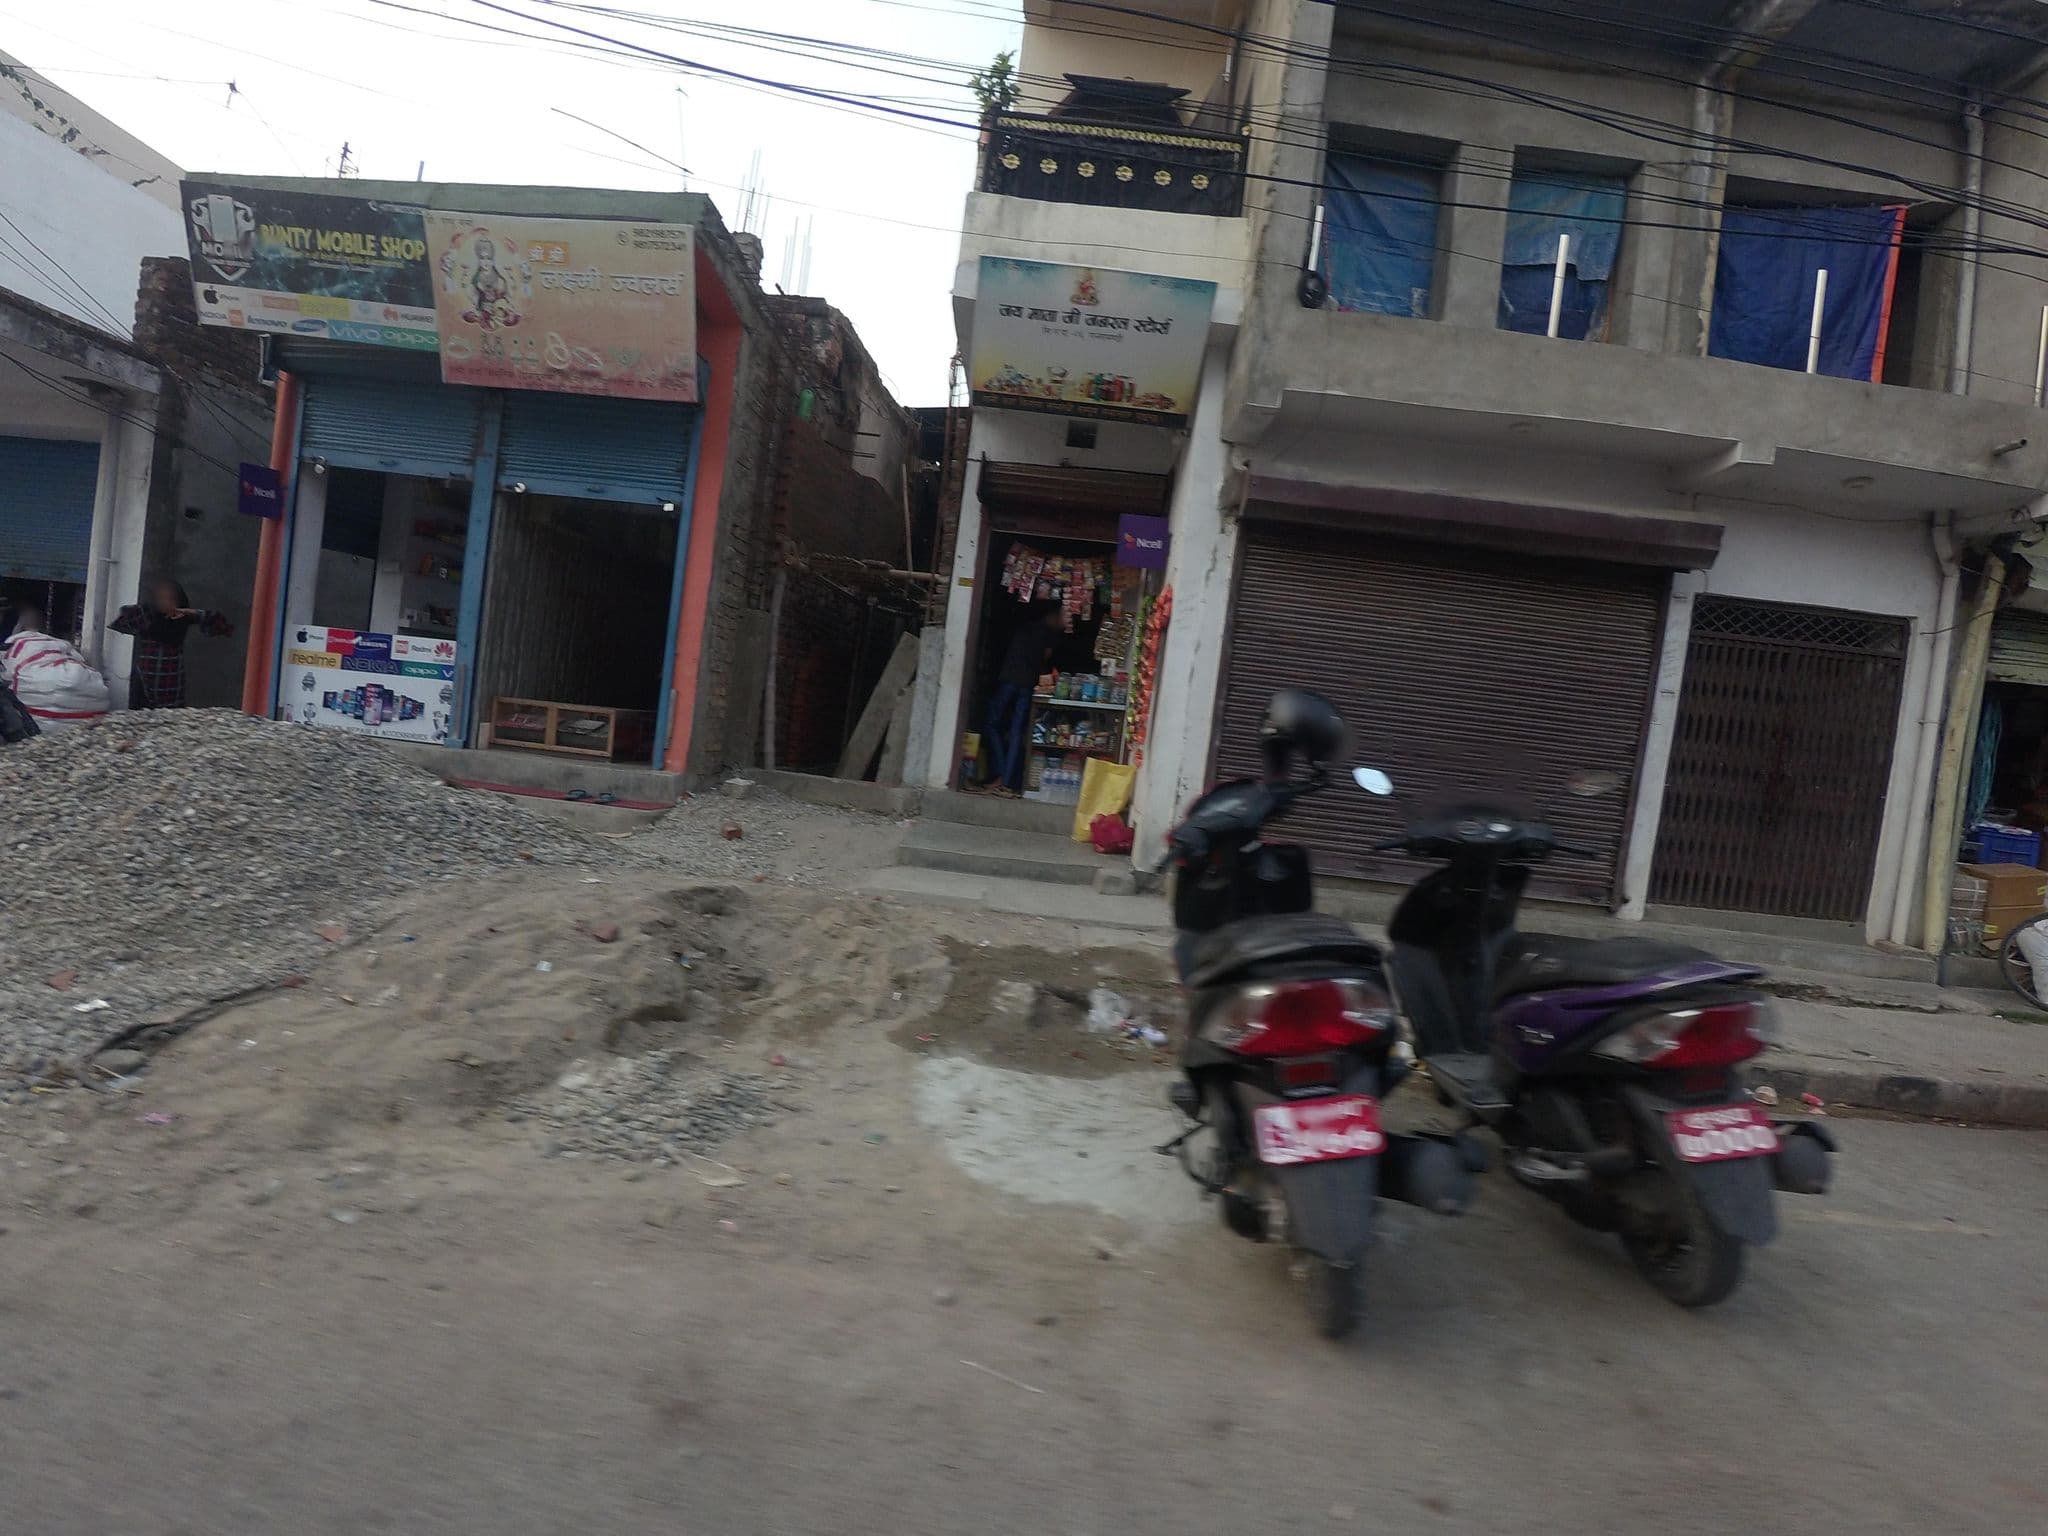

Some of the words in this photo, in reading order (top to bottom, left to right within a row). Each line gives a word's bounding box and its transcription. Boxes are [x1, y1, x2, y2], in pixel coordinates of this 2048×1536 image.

[316, 229, 377, 257] MOBILE
[380, 235, 426, 262] SHOP
[1136, 537, 1163, 550] Ncell
[291, 653, 337, 667] realme
[343, 656, 399, 674] NOKIA
